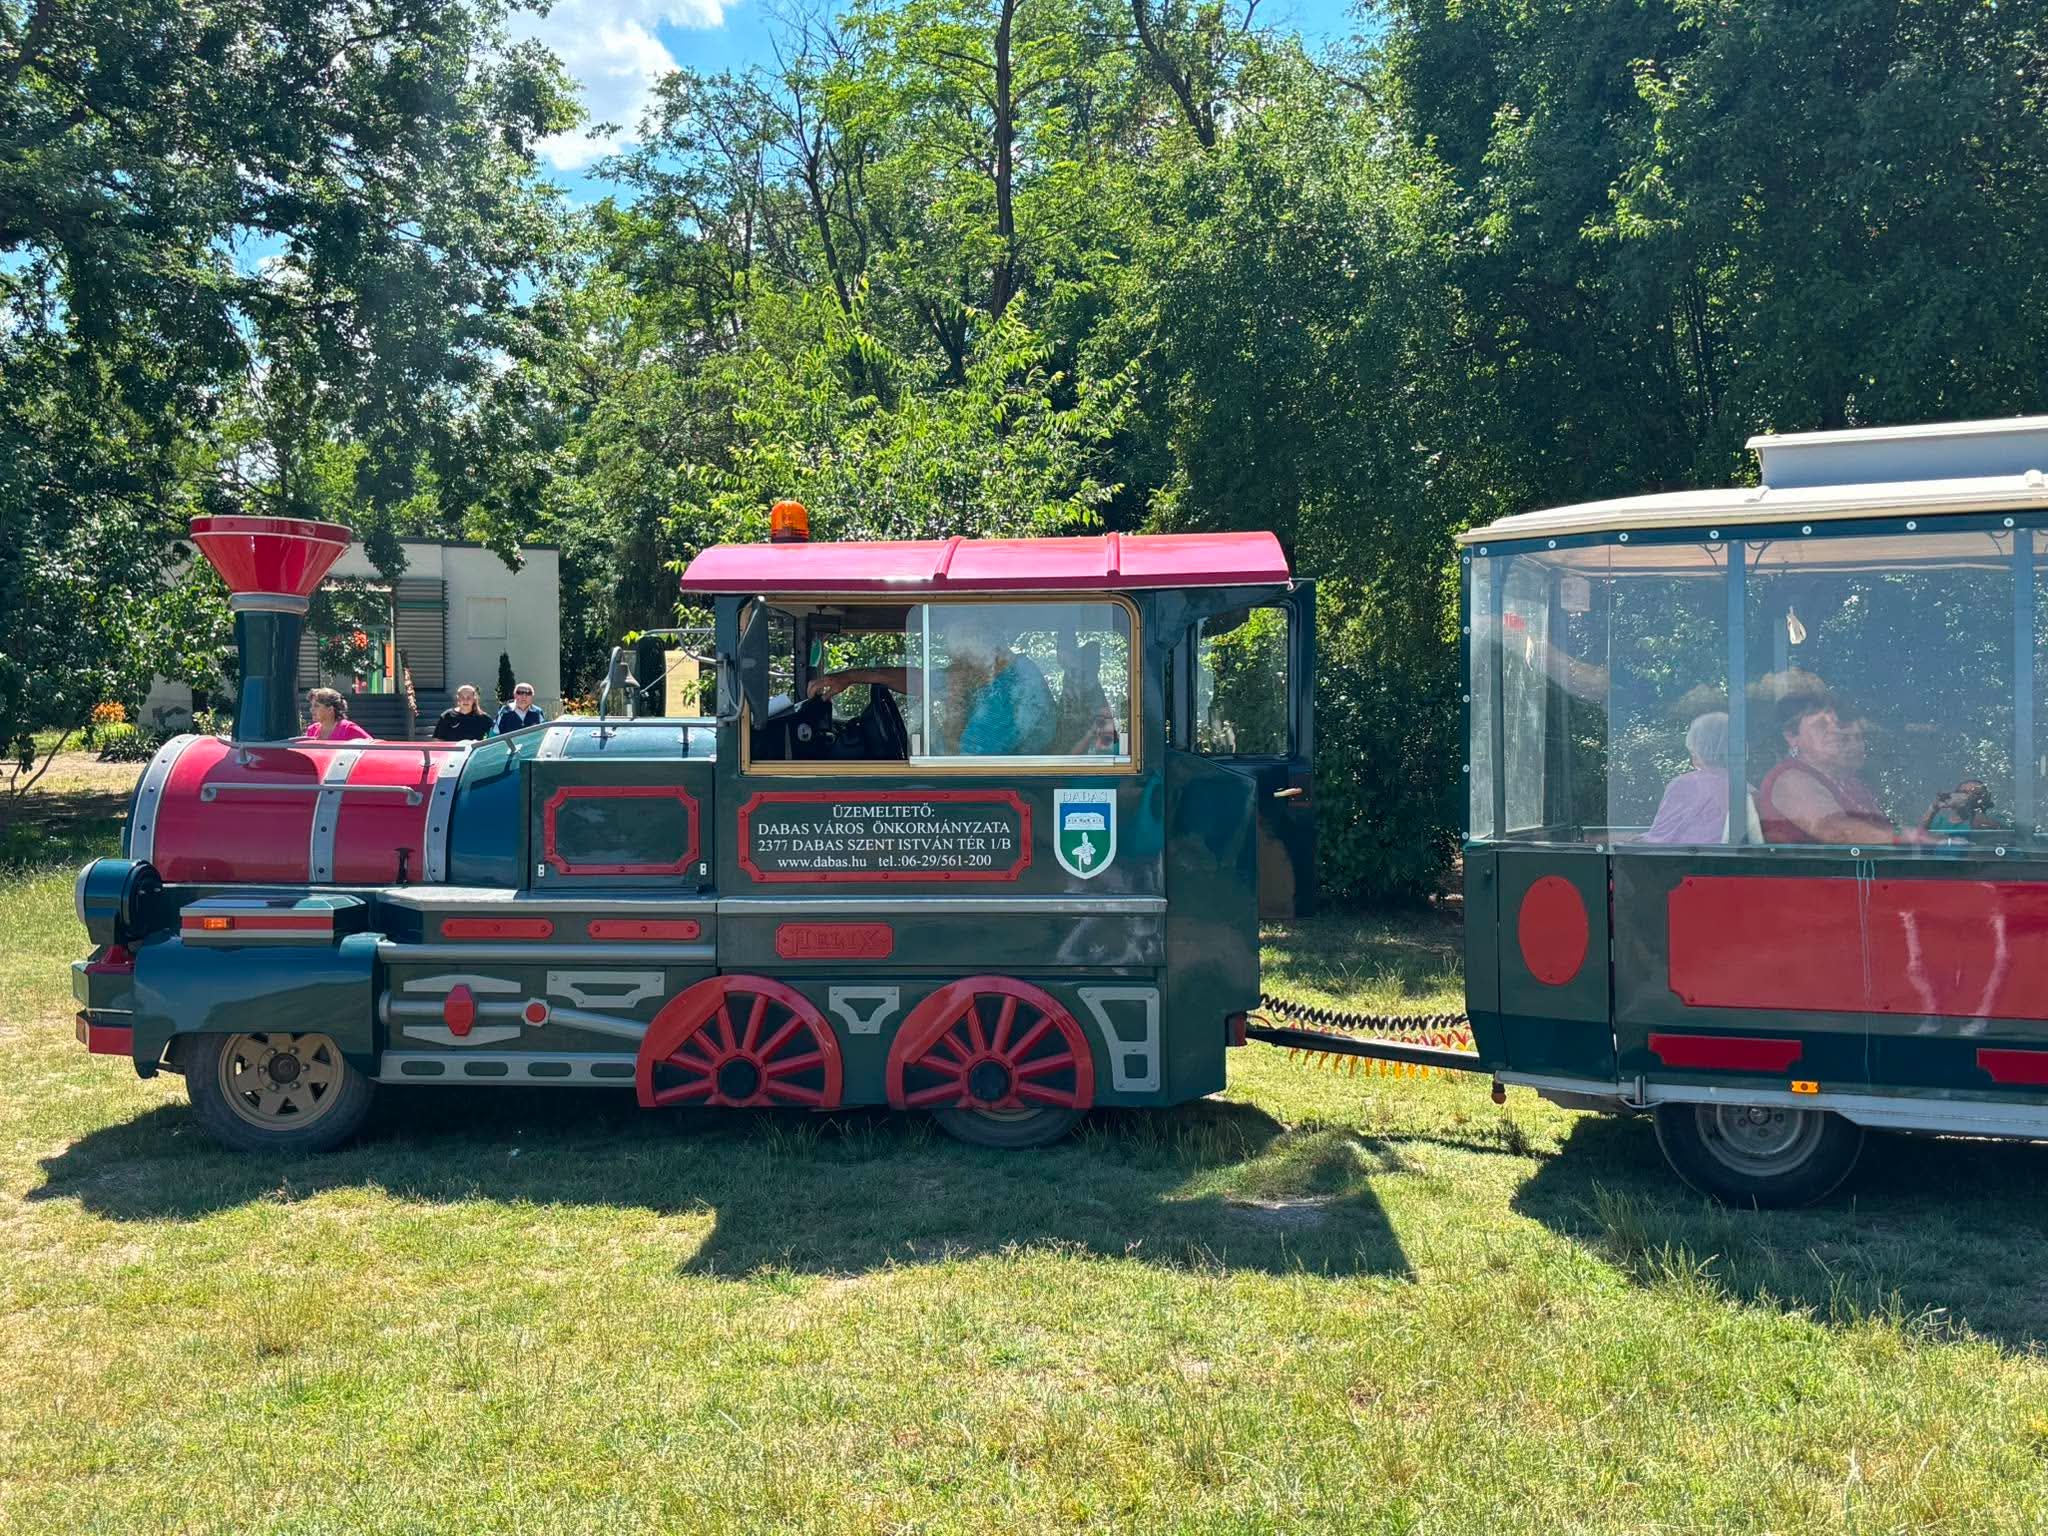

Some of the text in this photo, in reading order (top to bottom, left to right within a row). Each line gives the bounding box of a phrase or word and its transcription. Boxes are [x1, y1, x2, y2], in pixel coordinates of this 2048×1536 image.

[833, 803, 935, 818] ÜZEMELTETŐ:
[758, 819, 1010, 835] DABAS VÁROS ÖNKORMÁNYZATA
[758, 834, 1011, 852] 2377 DABAS SZENT ISTVÁN TÉR 1/B
[778, 854, 992, 867] www.dabas.hu tel.:06-29/561-200
